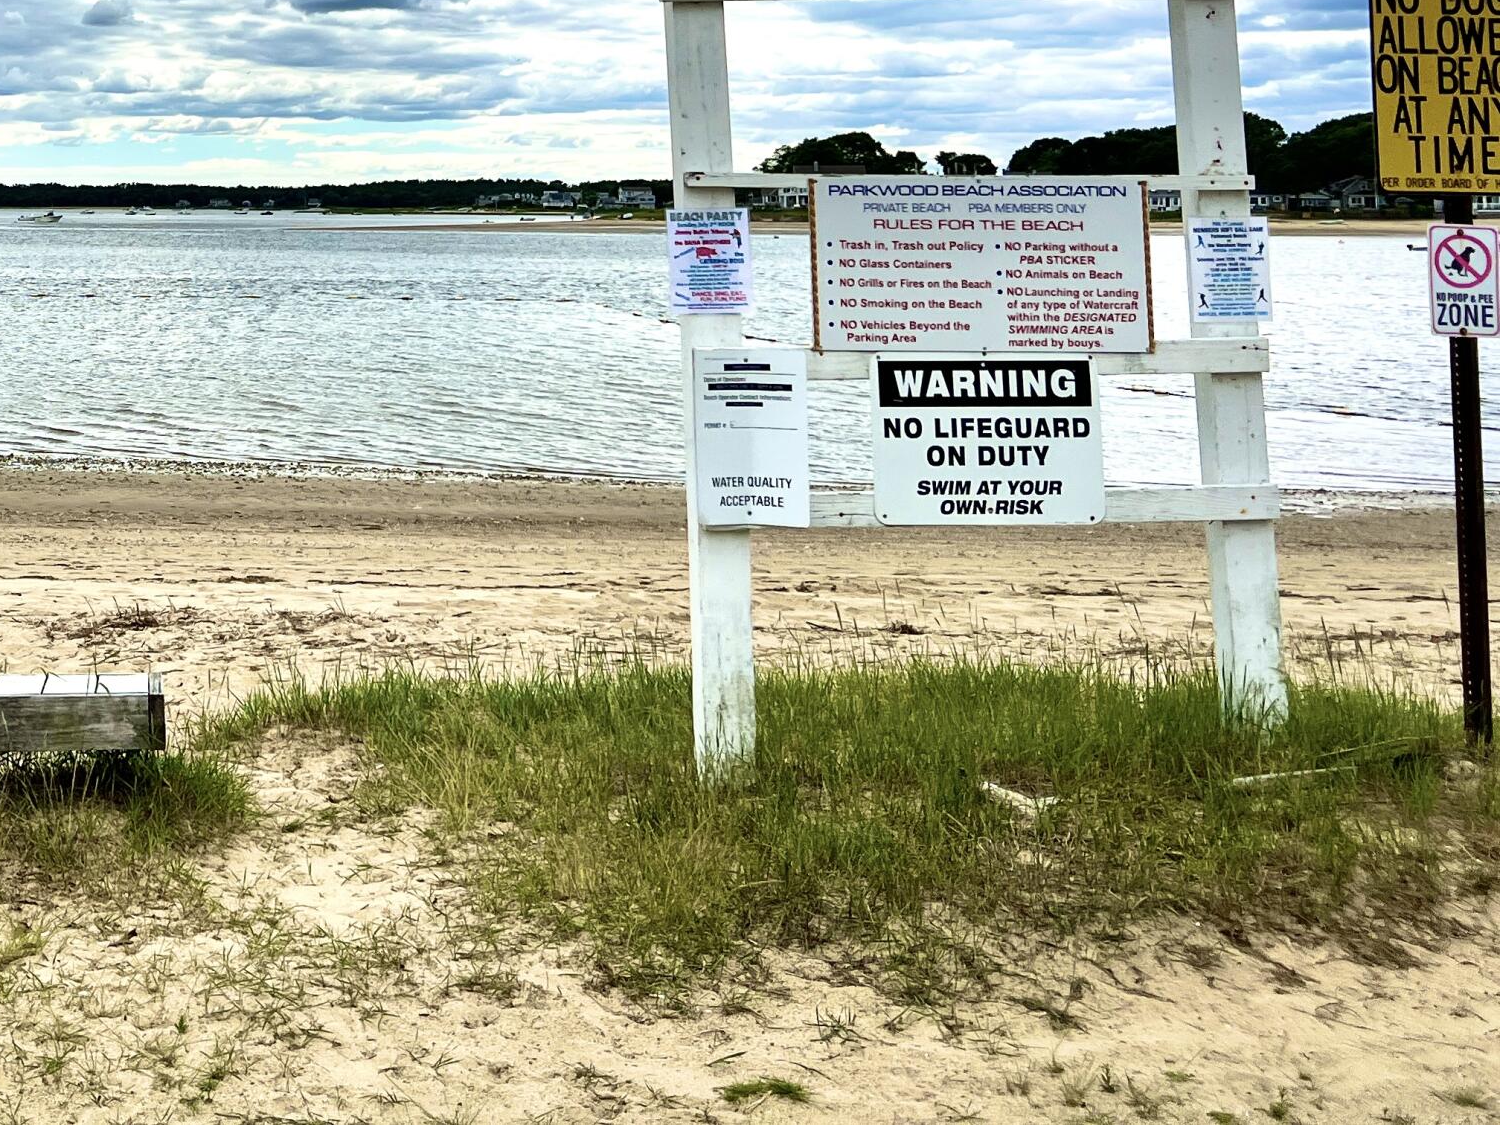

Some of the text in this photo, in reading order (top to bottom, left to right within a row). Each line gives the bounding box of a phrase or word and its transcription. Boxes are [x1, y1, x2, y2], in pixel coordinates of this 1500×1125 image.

[1376, 54, 1420, 94] ON
[1393, 96, 1427, 134] AT
[1408, 135, 1500, 174] TIME
[1382, 177, 1399, 187] PER
[1406, 177, 1435, 188] ORDER
[1442, 178, 1472, 188] BOARD
[1477, 179, 1489, 189] OF
[828, 185, 1127, 197] PARKWOOD BEACH ASSOCIATION
[863, 203, 951, 213] PRIVATE BEACH
[969, 203, 1086, 213] PBA MEMBERS ONLY
[670, 212, 742, 221] BEACH PARTY
[873, 219, 1084, 231] RULES FOR THE BEACH
[839, 240, 982, 253] Trash in, Trash out Policy
[1005, 242, 1021, 250] NO
[1025, 242, 1065, 253] Parking
[1069, 243, 1109, 252] without
[839, 259, 952, 269] NO Glass Containers
[1020, 256, 1095, 265] PBA STICKER
[1006, 270, 1024, 278] NO
[1025, 270, 1068, 279] Animals
[1089, 271, 1122, 279] Beach
[839, 279, 855, 287] NO
[858, 279, 884, 287] Grills
[887, 280, 897, 288] or
[900, 279, 925, 288] Fires
[943, 280, 958, 288] the
[961, 280, 992, 289] Beach
[1007, 287, 1139, 299] NO Launching or Landing
[1437, 292, 1446, 302] NO
[1448, 293, 1468, 302] POOP
[1479, 294, 1494, 303] PEE
[840, 299, 982, 310] NO Smoking on the Beach
[1007, 301, 1138, 311] of any type of Watercraft
[1007, 313, 1136, 322] within the DESIGNATED
[1437, 303, 1494, 327] ZONE
[840, 320, 970, 332] NO Vehicles Beyond the
[1008, 325, 1068, 334] SWIMMING
[1071, 326, 1102, 334] AREA
[847, 333, 916, 344] Parking Area
[1008, 339, 1104, 349] marked by bouys.
[893, 369, 1076, 398] WARNING
[884, 417, 1090, 439] NO LIFEGUARD
[926, 445, 1049, 467] ON DUTY
[712, 477, 792, 489] WATER QUALITY
[917, 480, 1063, 496] SWIM AT YOUR
[720, 496, 784, 507] ACCEPTABLE
[940, 500, 1044, 515] OWN RISK
